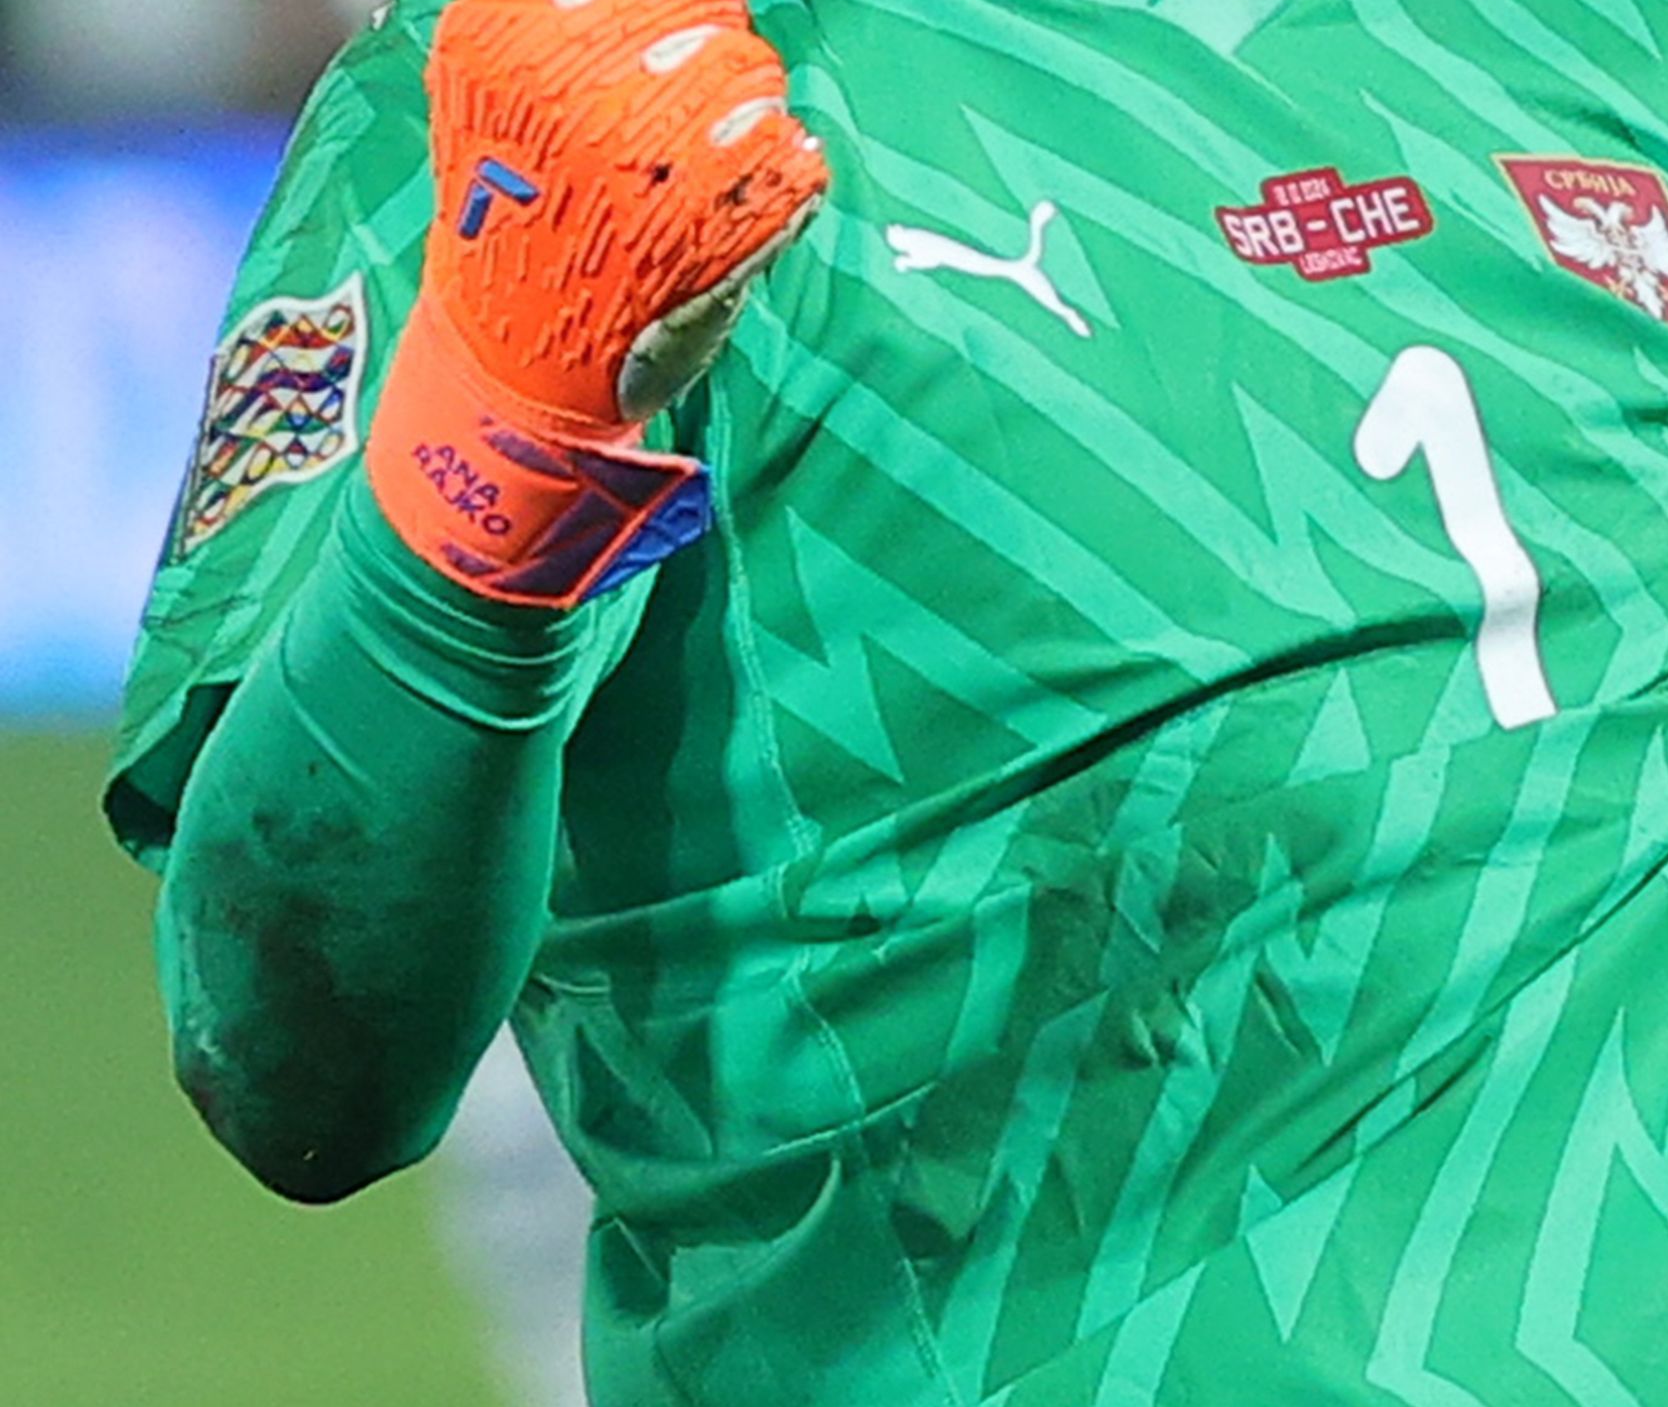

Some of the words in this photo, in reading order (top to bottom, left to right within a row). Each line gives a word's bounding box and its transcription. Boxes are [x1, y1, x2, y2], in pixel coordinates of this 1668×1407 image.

[1222, 208, 1306, 258] SRB
[1329, 186, 1421, 244] CHE
[436, 445, 501, 507] ANA
[1353, 344, 1559, 731] 1
